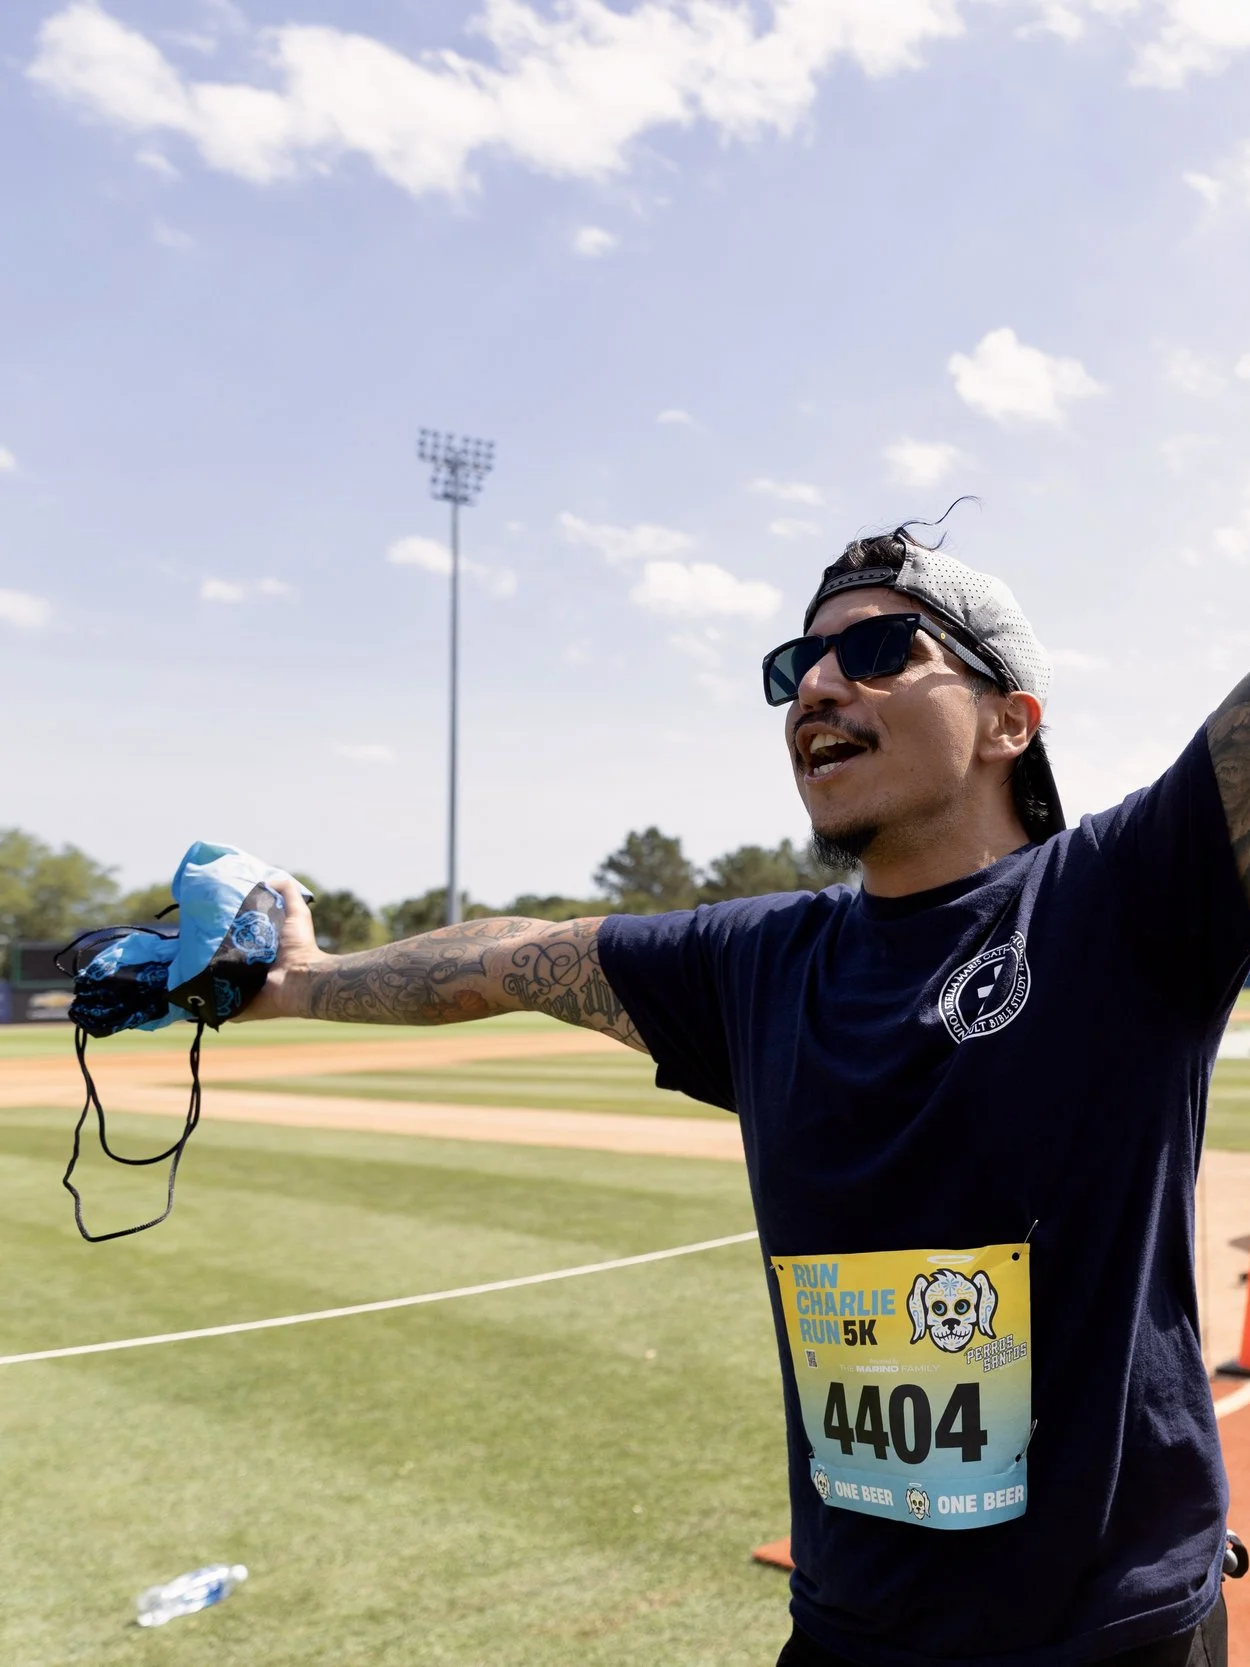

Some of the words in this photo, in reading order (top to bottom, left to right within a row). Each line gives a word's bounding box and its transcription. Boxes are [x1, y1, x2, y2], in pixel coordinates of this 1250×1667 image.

[944, 982, 960, 1009] STELLA
[954, 959, 982, 983] MARIS
[945, 1009, 965, 1038] YOUN
[989, 1007, 1013, 1028] BIBLE
[1010, 974, 1027, 1008] STUDY
[792, 1263, 838, 1289] RUN
[796, 1289, 896, 1316] CHARLIE
[799, 1318, 841, 1345] RUN
[843, 1319, 878, 1346] 5K
[965, 1334, 1013, 1364] PERROS
[983, 1342, 1028, 1372] SANTOS
[856, 1364, 899, 1373] MARINO
[901, 1364, 940, 1373] FAMILY
[823, 1381, 988, 1465] 4404
[835, 1480, 860, 1500] ONE
[861, 1485, 894, 1507] BEER
[937, 1495, 978, 1514] ONE
[983, 1484, 1025, 1511] BEER
